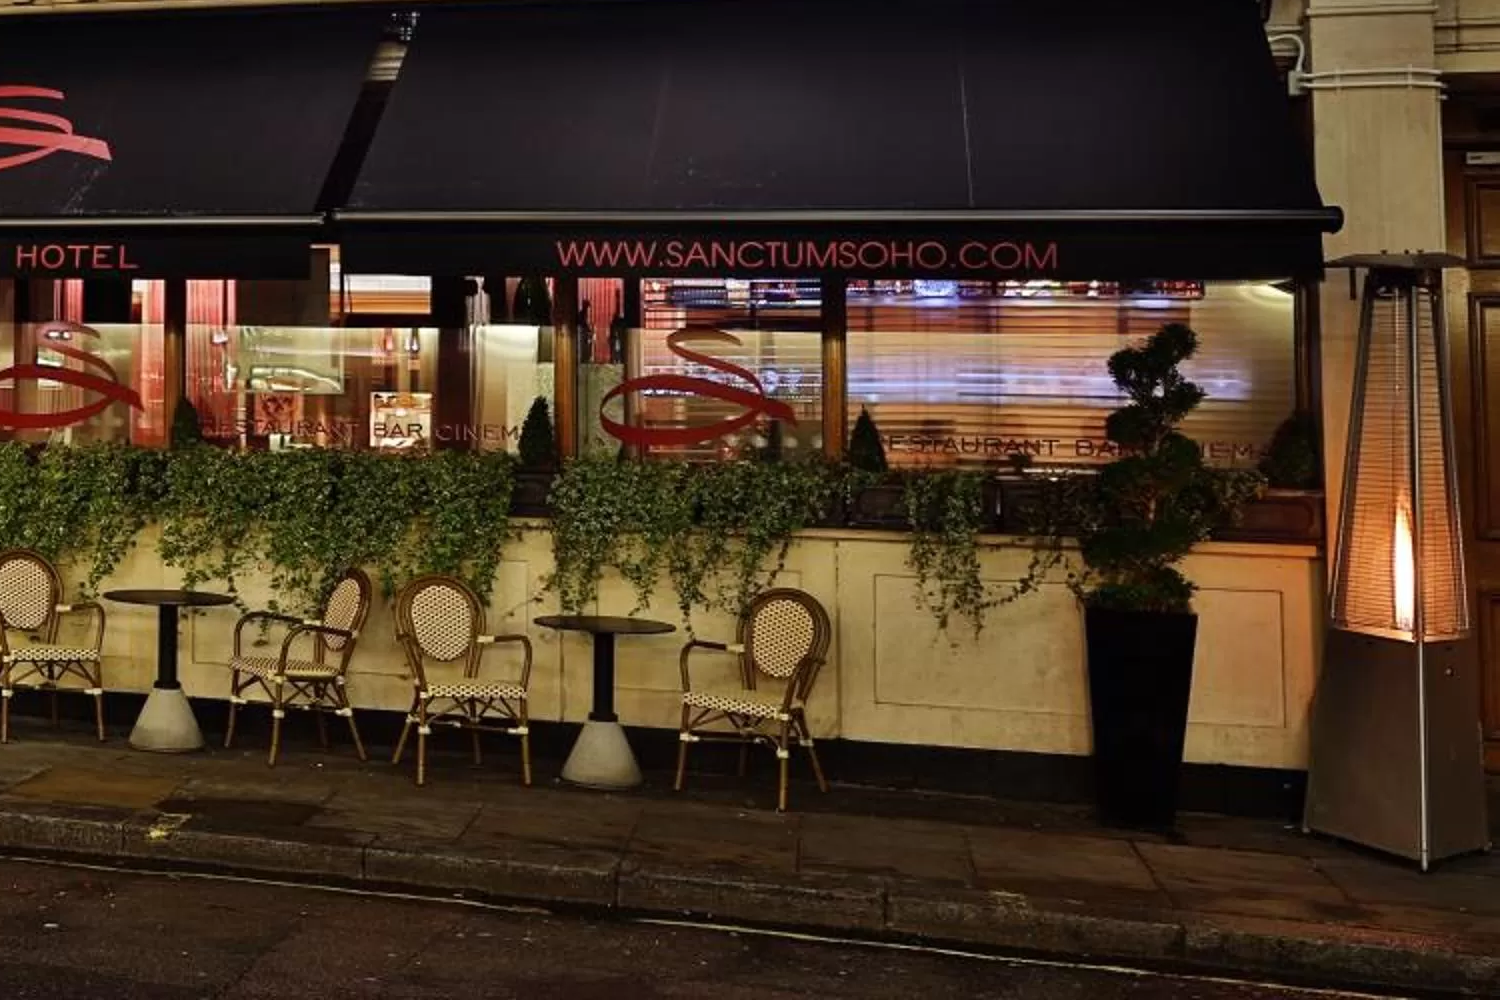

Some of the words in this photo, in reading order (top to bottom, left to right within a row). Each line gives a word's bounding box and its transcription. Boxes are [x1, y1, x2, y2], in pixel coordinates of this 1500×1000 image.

[16, 244, 140, 270] HOTEL
[556, 240, 1058, 269] WWW.SANCTUMSOHO.COM
[373, 421, 423, 440] BAR
[435, 422, 522, 442] CINEM
